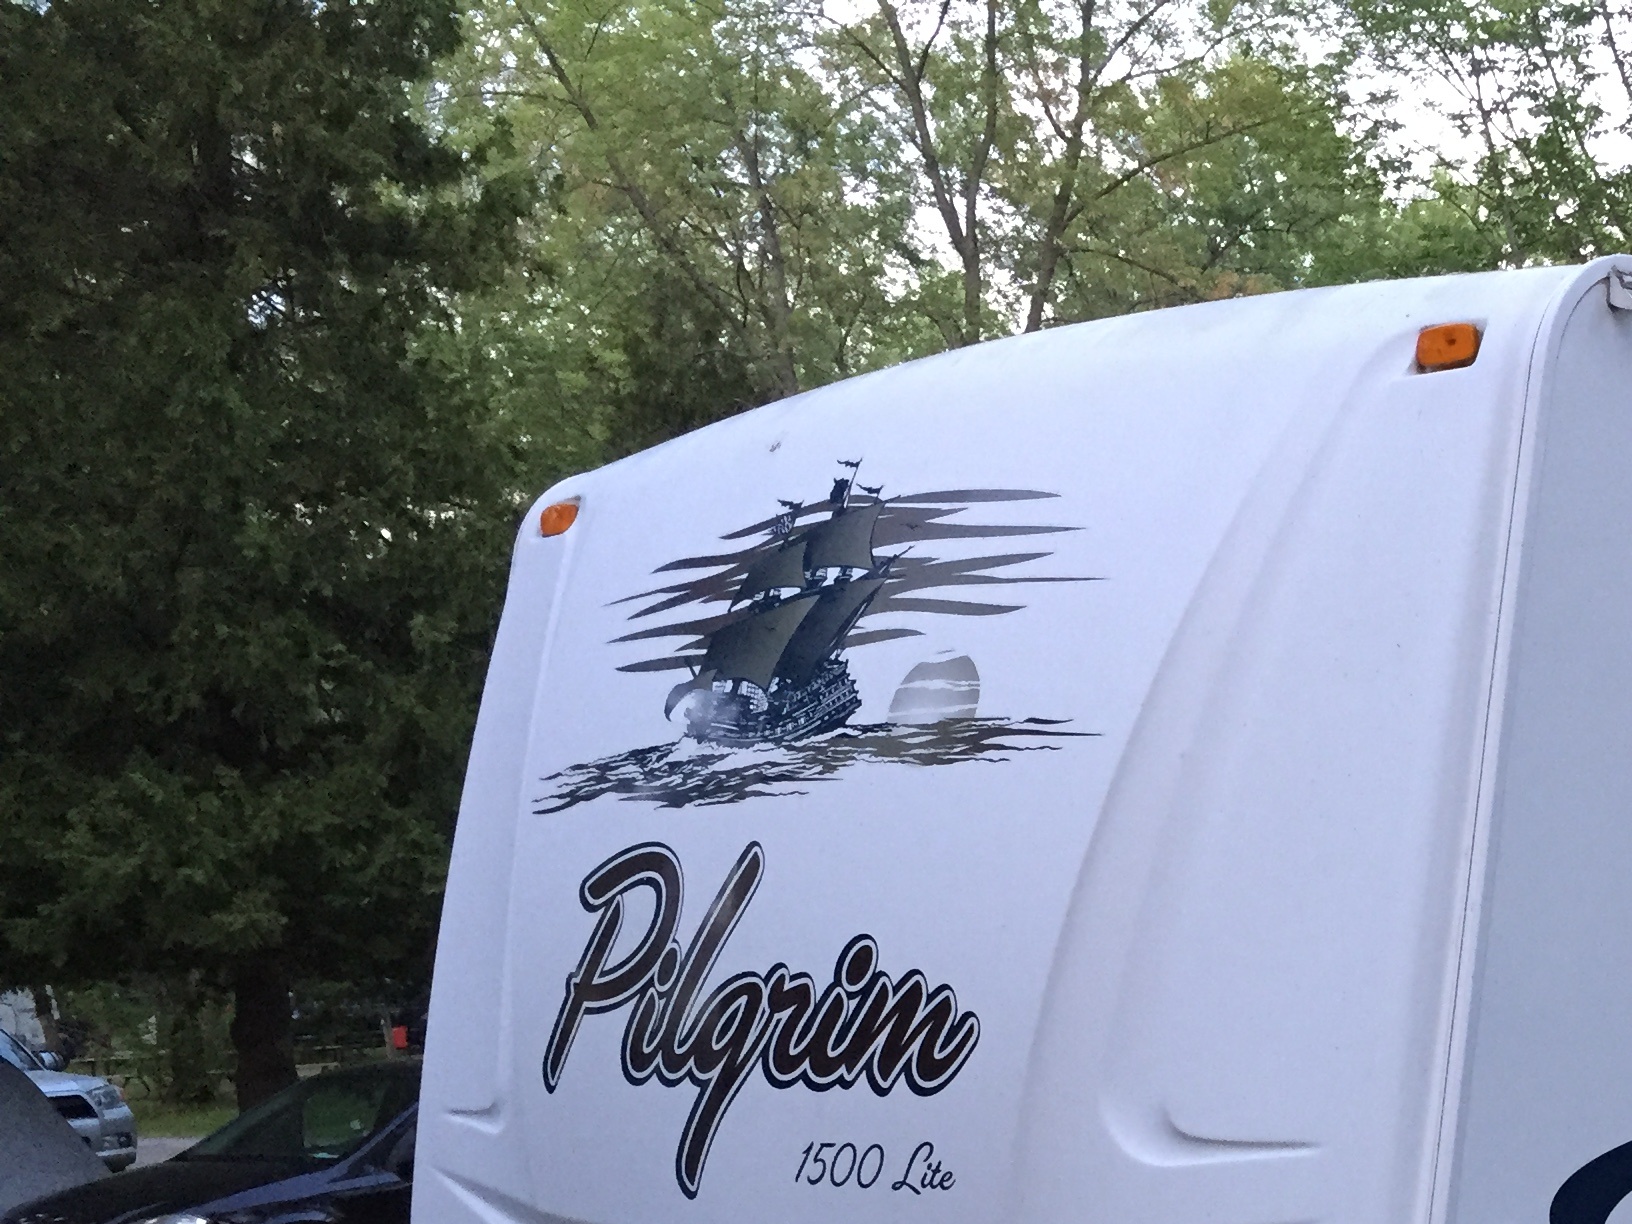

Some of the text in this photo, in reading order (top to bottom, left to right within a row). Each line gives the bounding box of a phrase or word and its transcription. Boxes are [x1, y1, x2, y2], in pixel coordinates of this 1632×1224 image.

[543, 840, 981, 1199] Pilgrim
[794, 1141, 956, 1195] 1500 Lite
